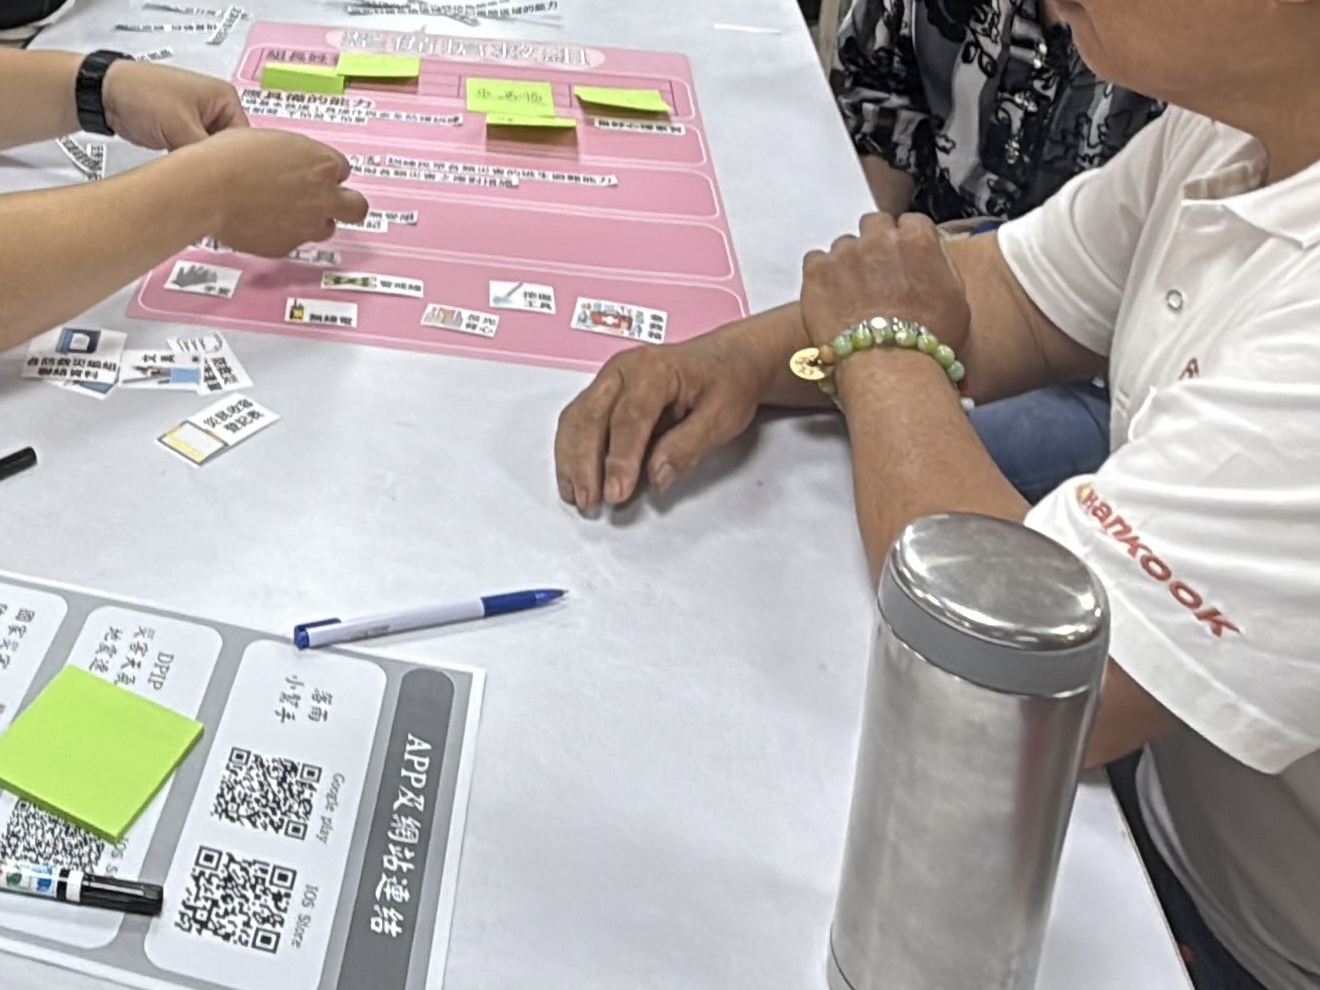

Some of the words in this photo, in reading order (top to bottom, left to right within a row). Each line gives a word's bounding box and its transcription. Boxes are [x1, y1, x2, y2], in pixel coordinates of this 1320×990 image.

[147, 651, 174, 691] DPIP
[308, 687, 334, 723] 落雨
[325, 772, 346, 814] Google
[370, 732, 432, 938] APP及網站連結
[291, 913, 311, 948] Store
